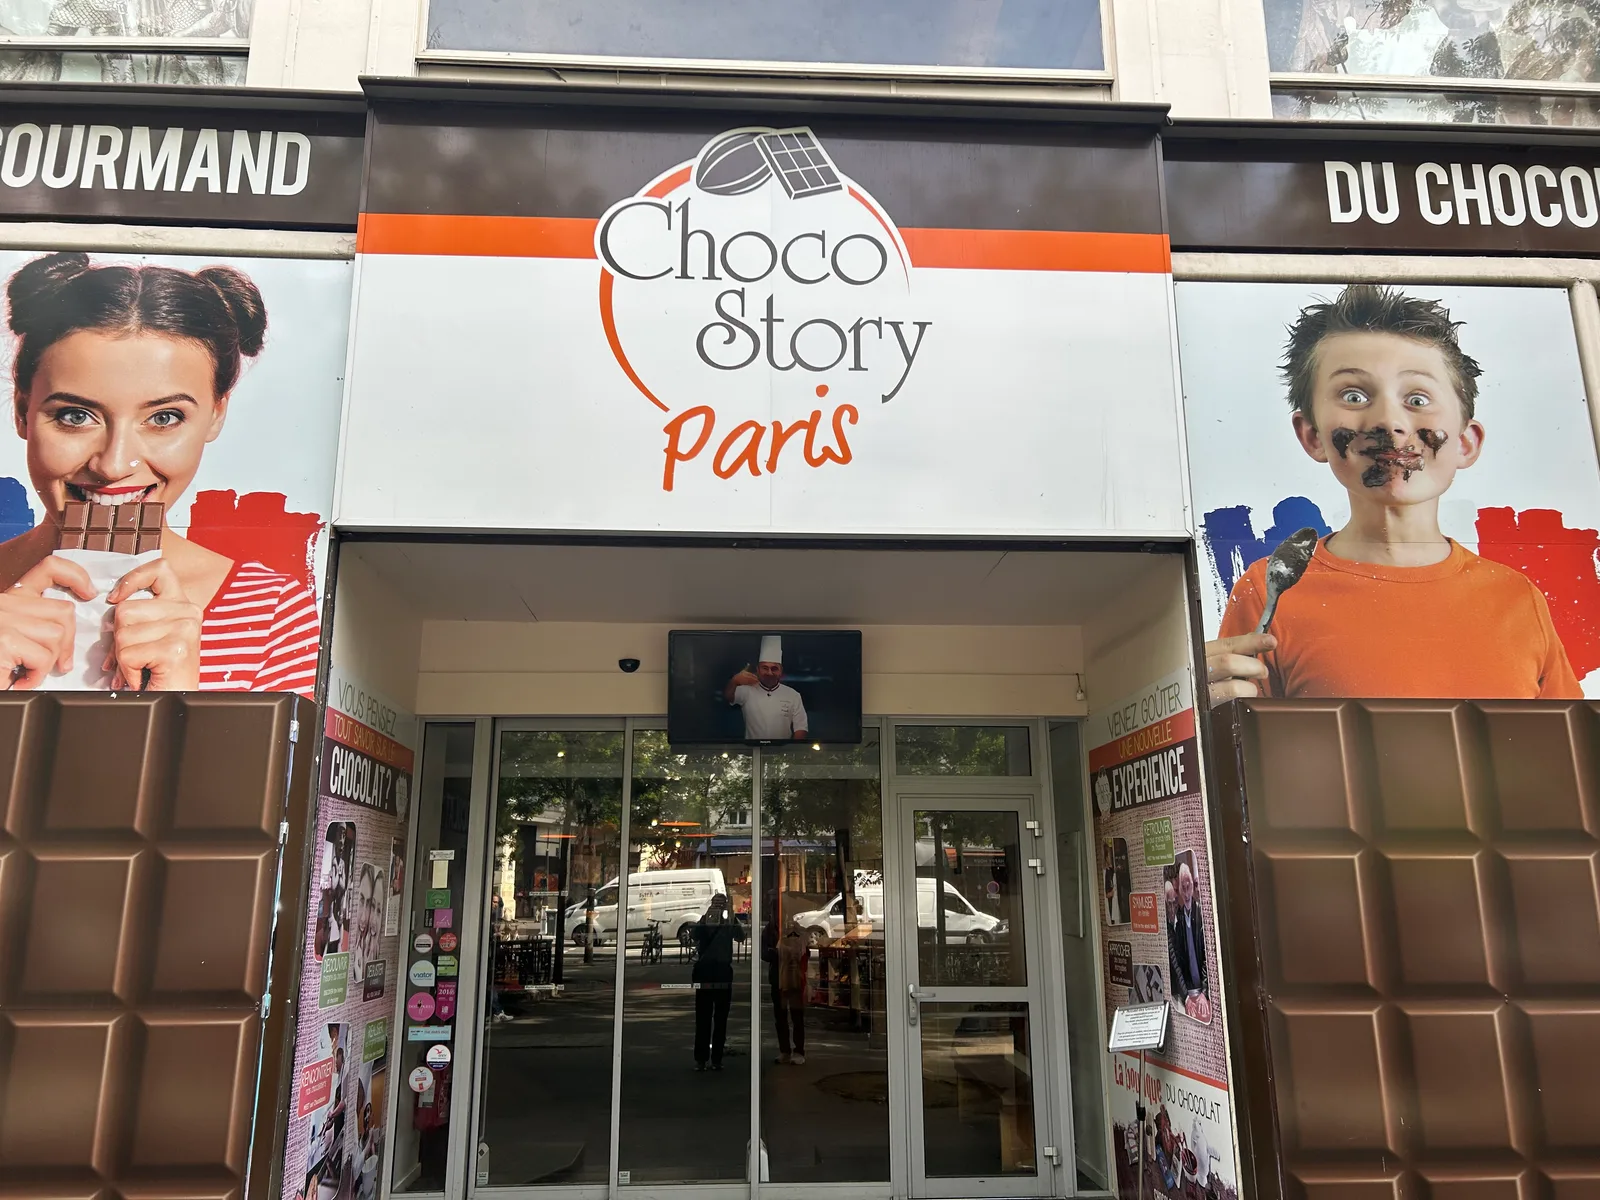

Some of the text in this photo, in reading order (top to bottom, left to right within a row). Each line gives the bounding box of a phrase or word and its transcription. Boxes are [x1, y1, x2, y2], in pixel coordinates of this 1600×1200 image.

[0, 122, 312, 197] OURMAND
[1324, 160, 1600, 229] DU CHOCO
[600, 197, 888, 286] Choco
[695, 287, 933, 404] Story
[334, 713, 353, 742] TOUT
[338, 677, 397, 738] VOUS PENSEZ
[1106, 682, 1184, 740] VENEZ GOÛTER
[1118, 720, 1173, 760] UNE NOUVELLE
[1112, 745, 1188, 809] EXPERIENCE
[1114, 1054, 1221, 1124] La bouque DU CHOCOLAT
